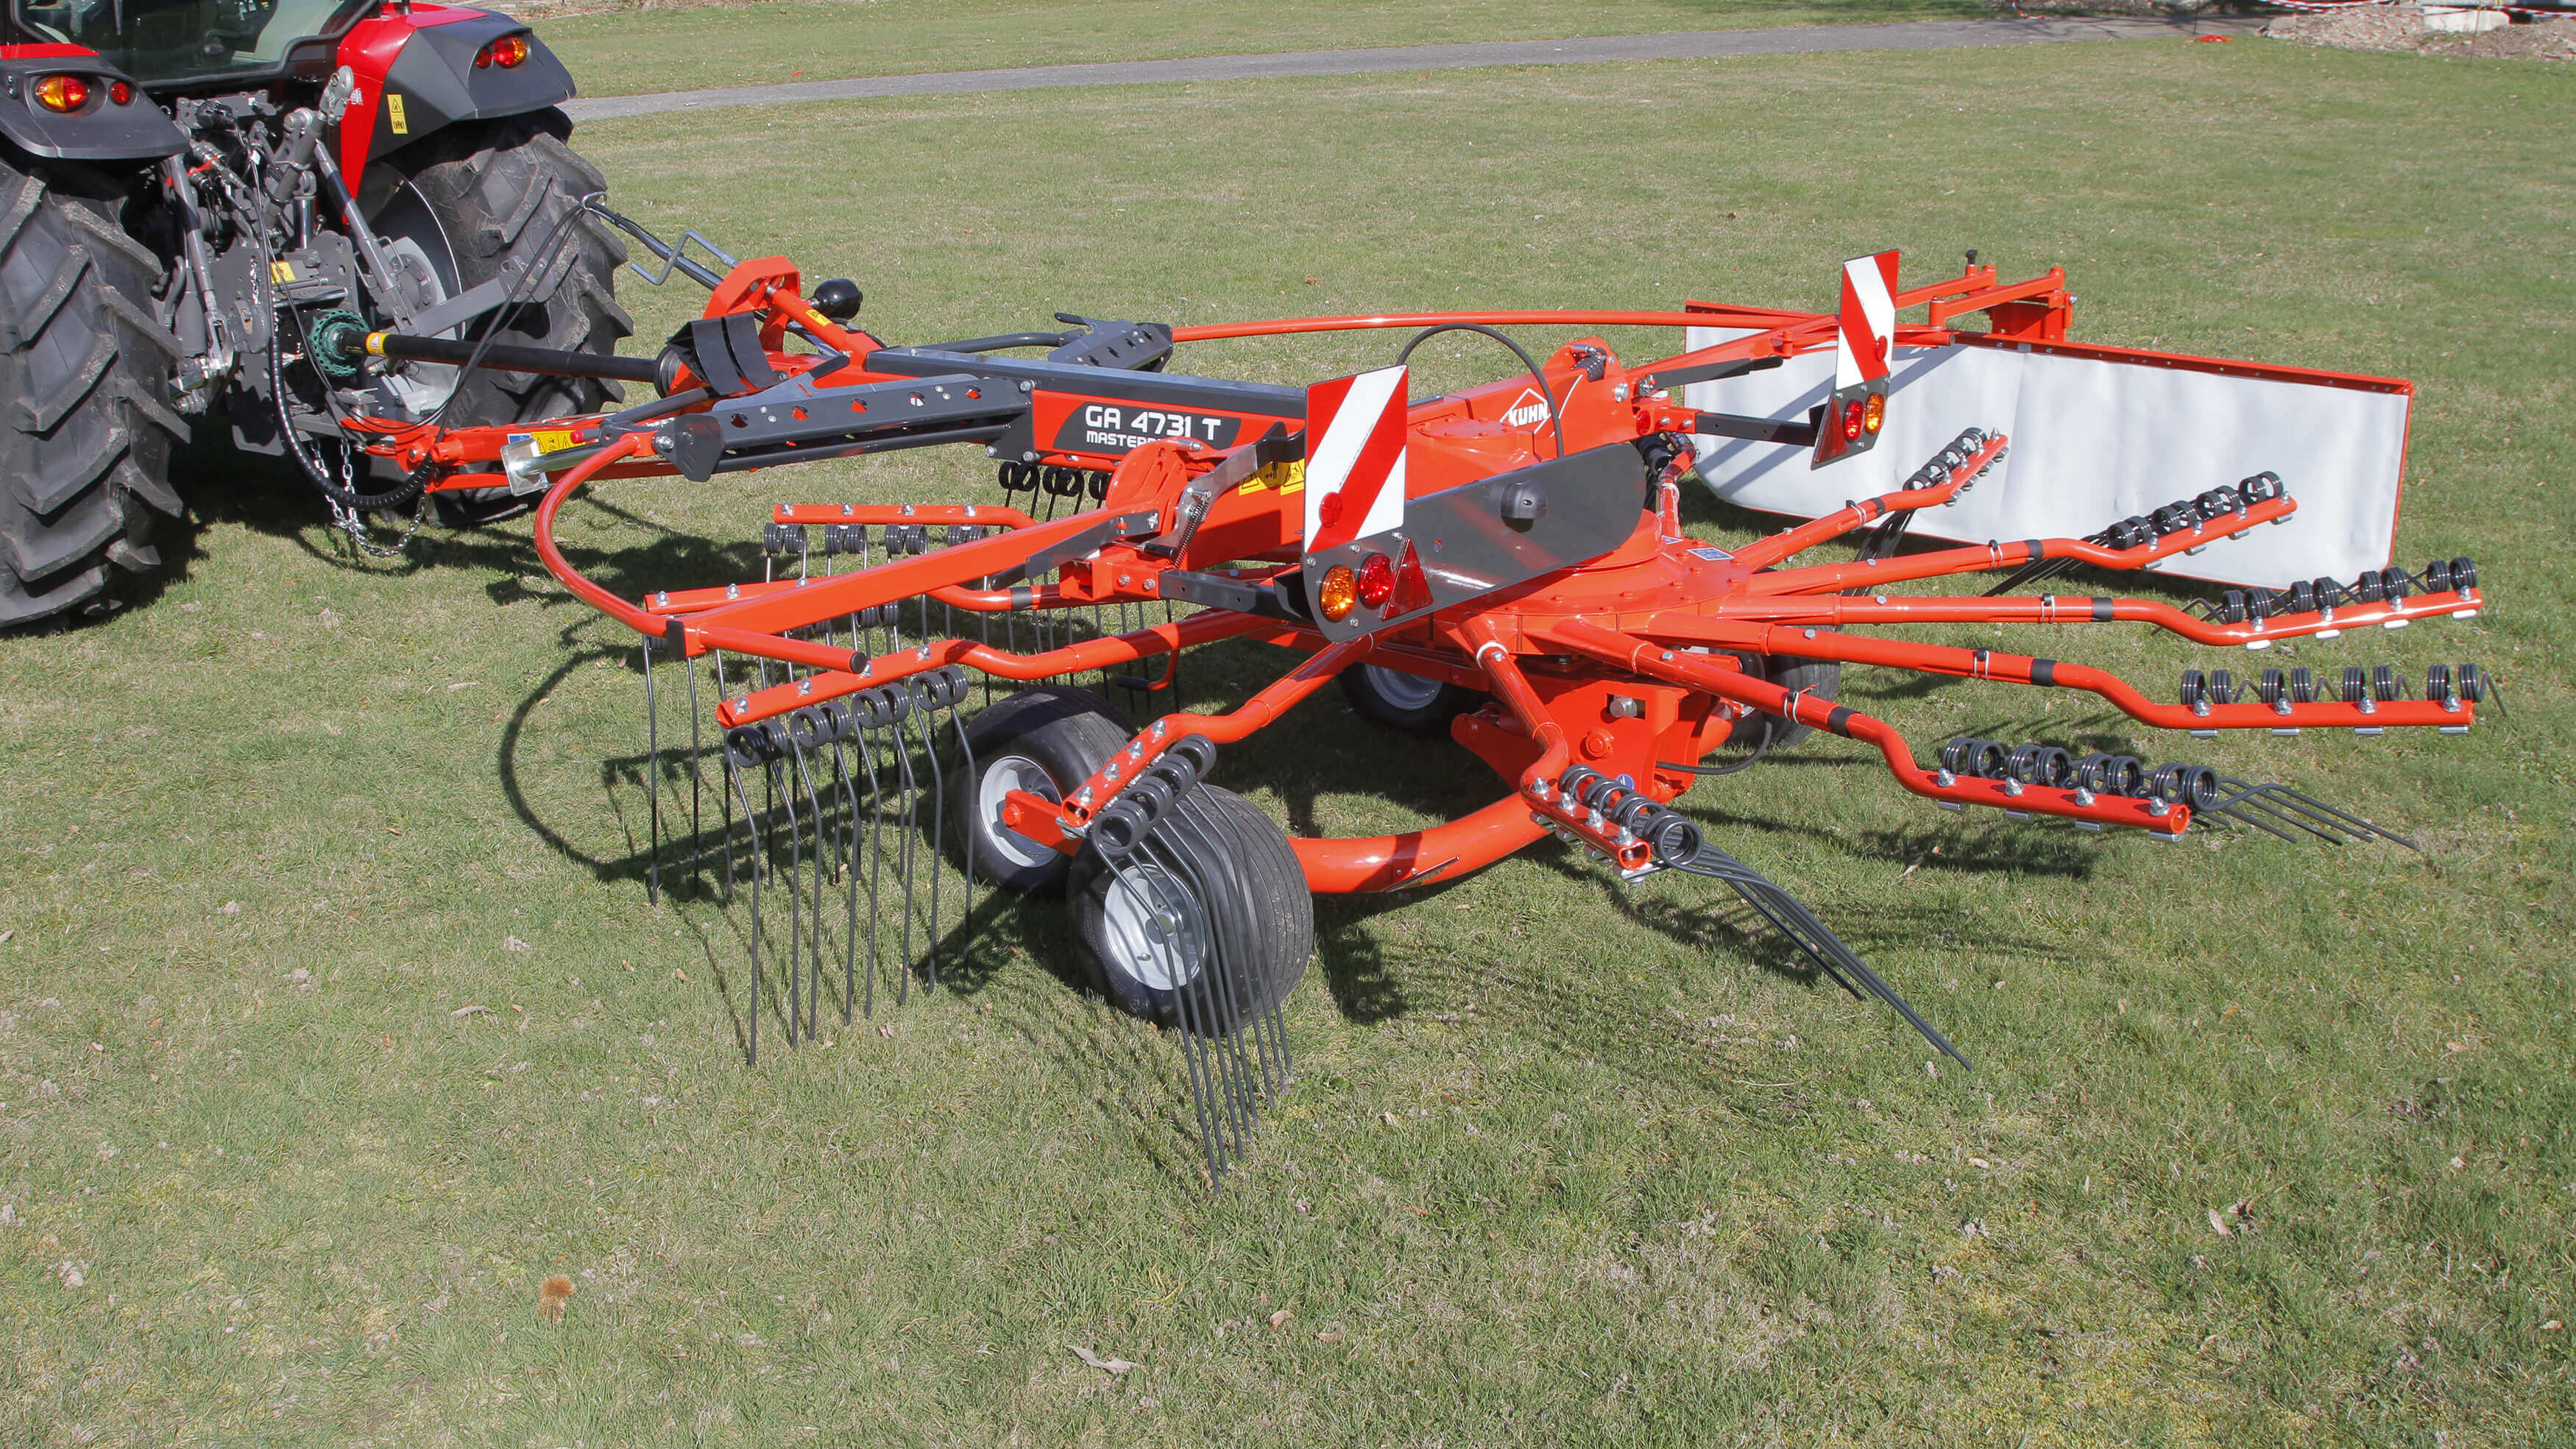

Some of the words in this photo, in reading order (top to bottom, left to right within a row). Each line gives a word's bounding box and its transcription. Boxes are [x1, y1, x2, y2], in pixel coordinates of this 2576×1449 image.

[1085, 405, 1122, 431] GA
[1130, 411, 1192, 438] 4731
[1201, 417, 1222, 441] T
[1508, 403, 1549, 428] KUHN
[1086, 430, 1161, 448] MASTER
